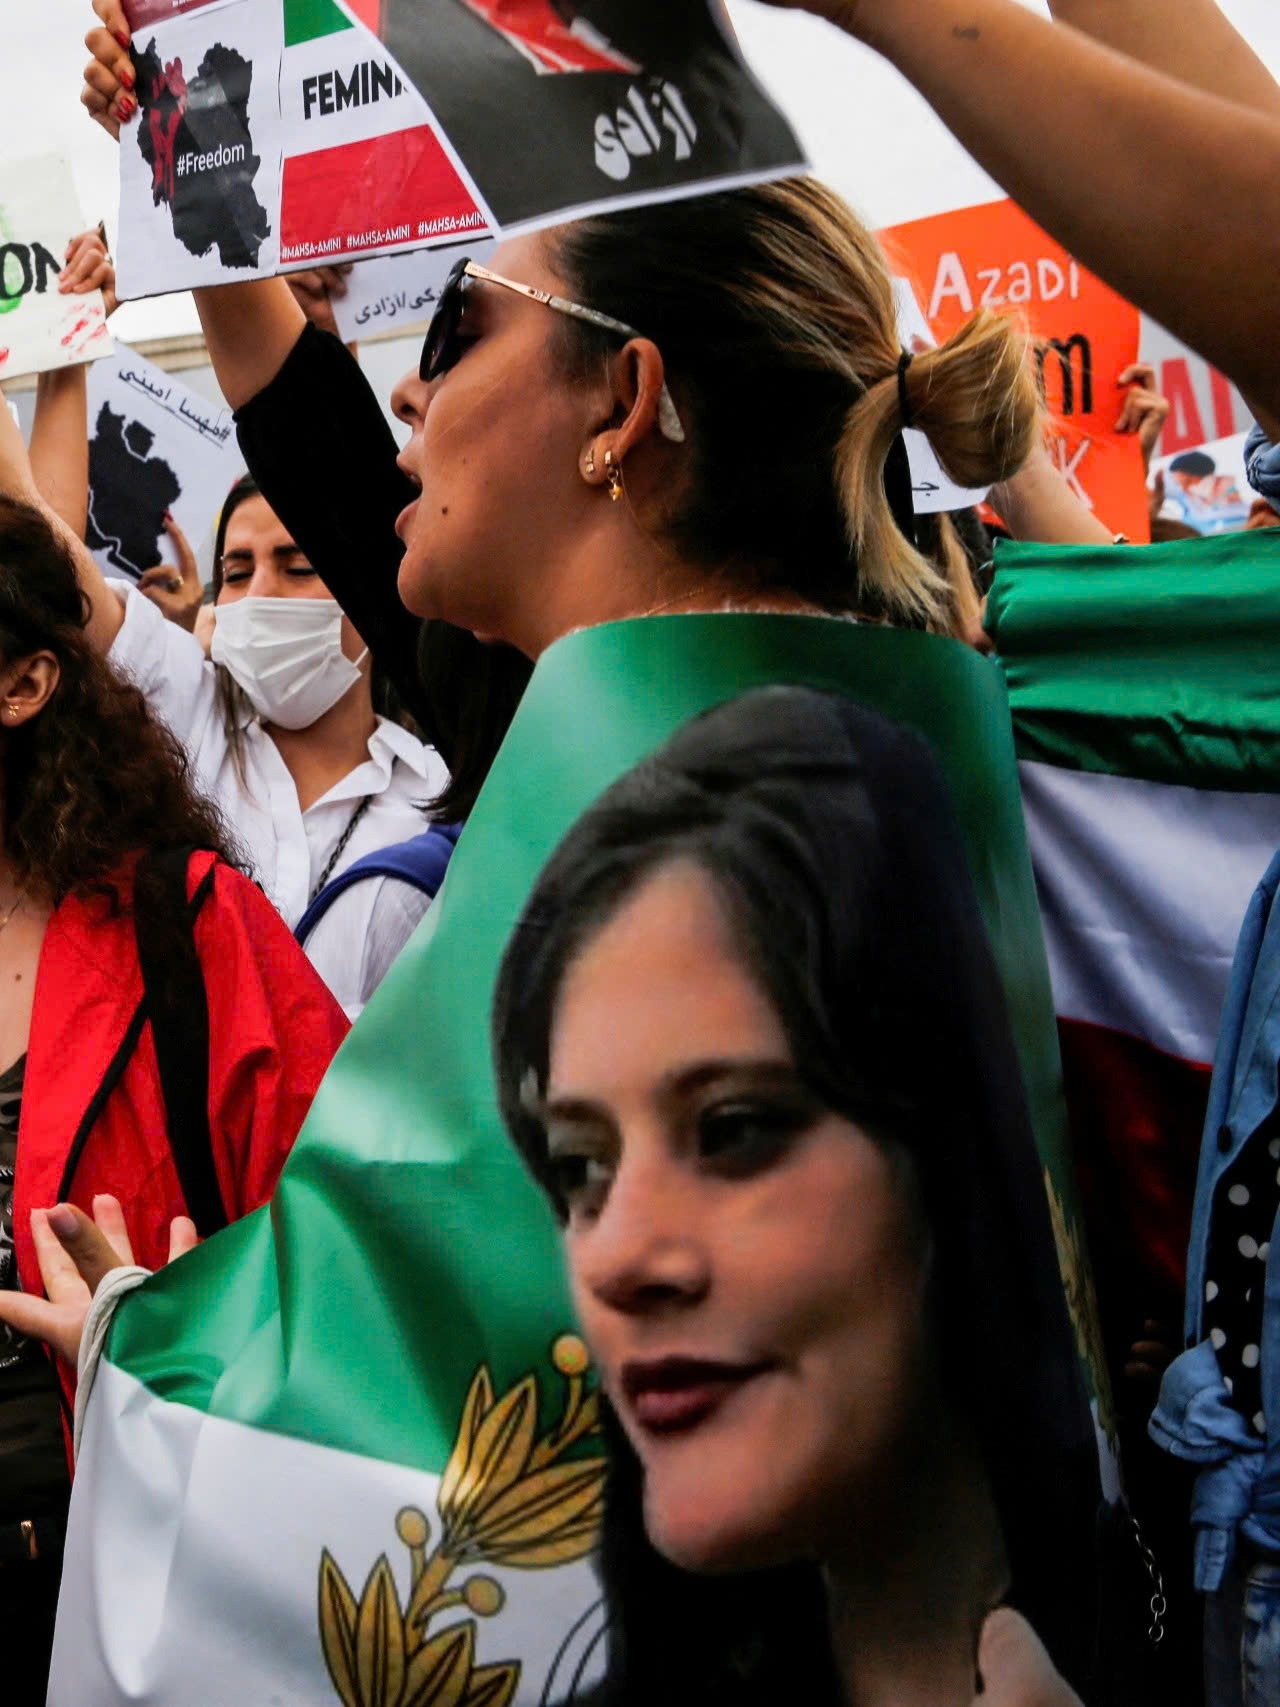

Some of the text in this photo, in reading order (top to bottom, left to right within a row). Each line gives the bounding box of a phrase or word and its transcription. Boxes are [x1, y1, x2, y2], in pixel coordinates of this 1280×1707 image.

[594, 77, 698, 181] آزادی
[176, 143, 245, 177] #Freedom
[281, 237, 342, 260] #MAHSA-AMINI
[347, 224, 411, 249] #MAHSA-AMINI
